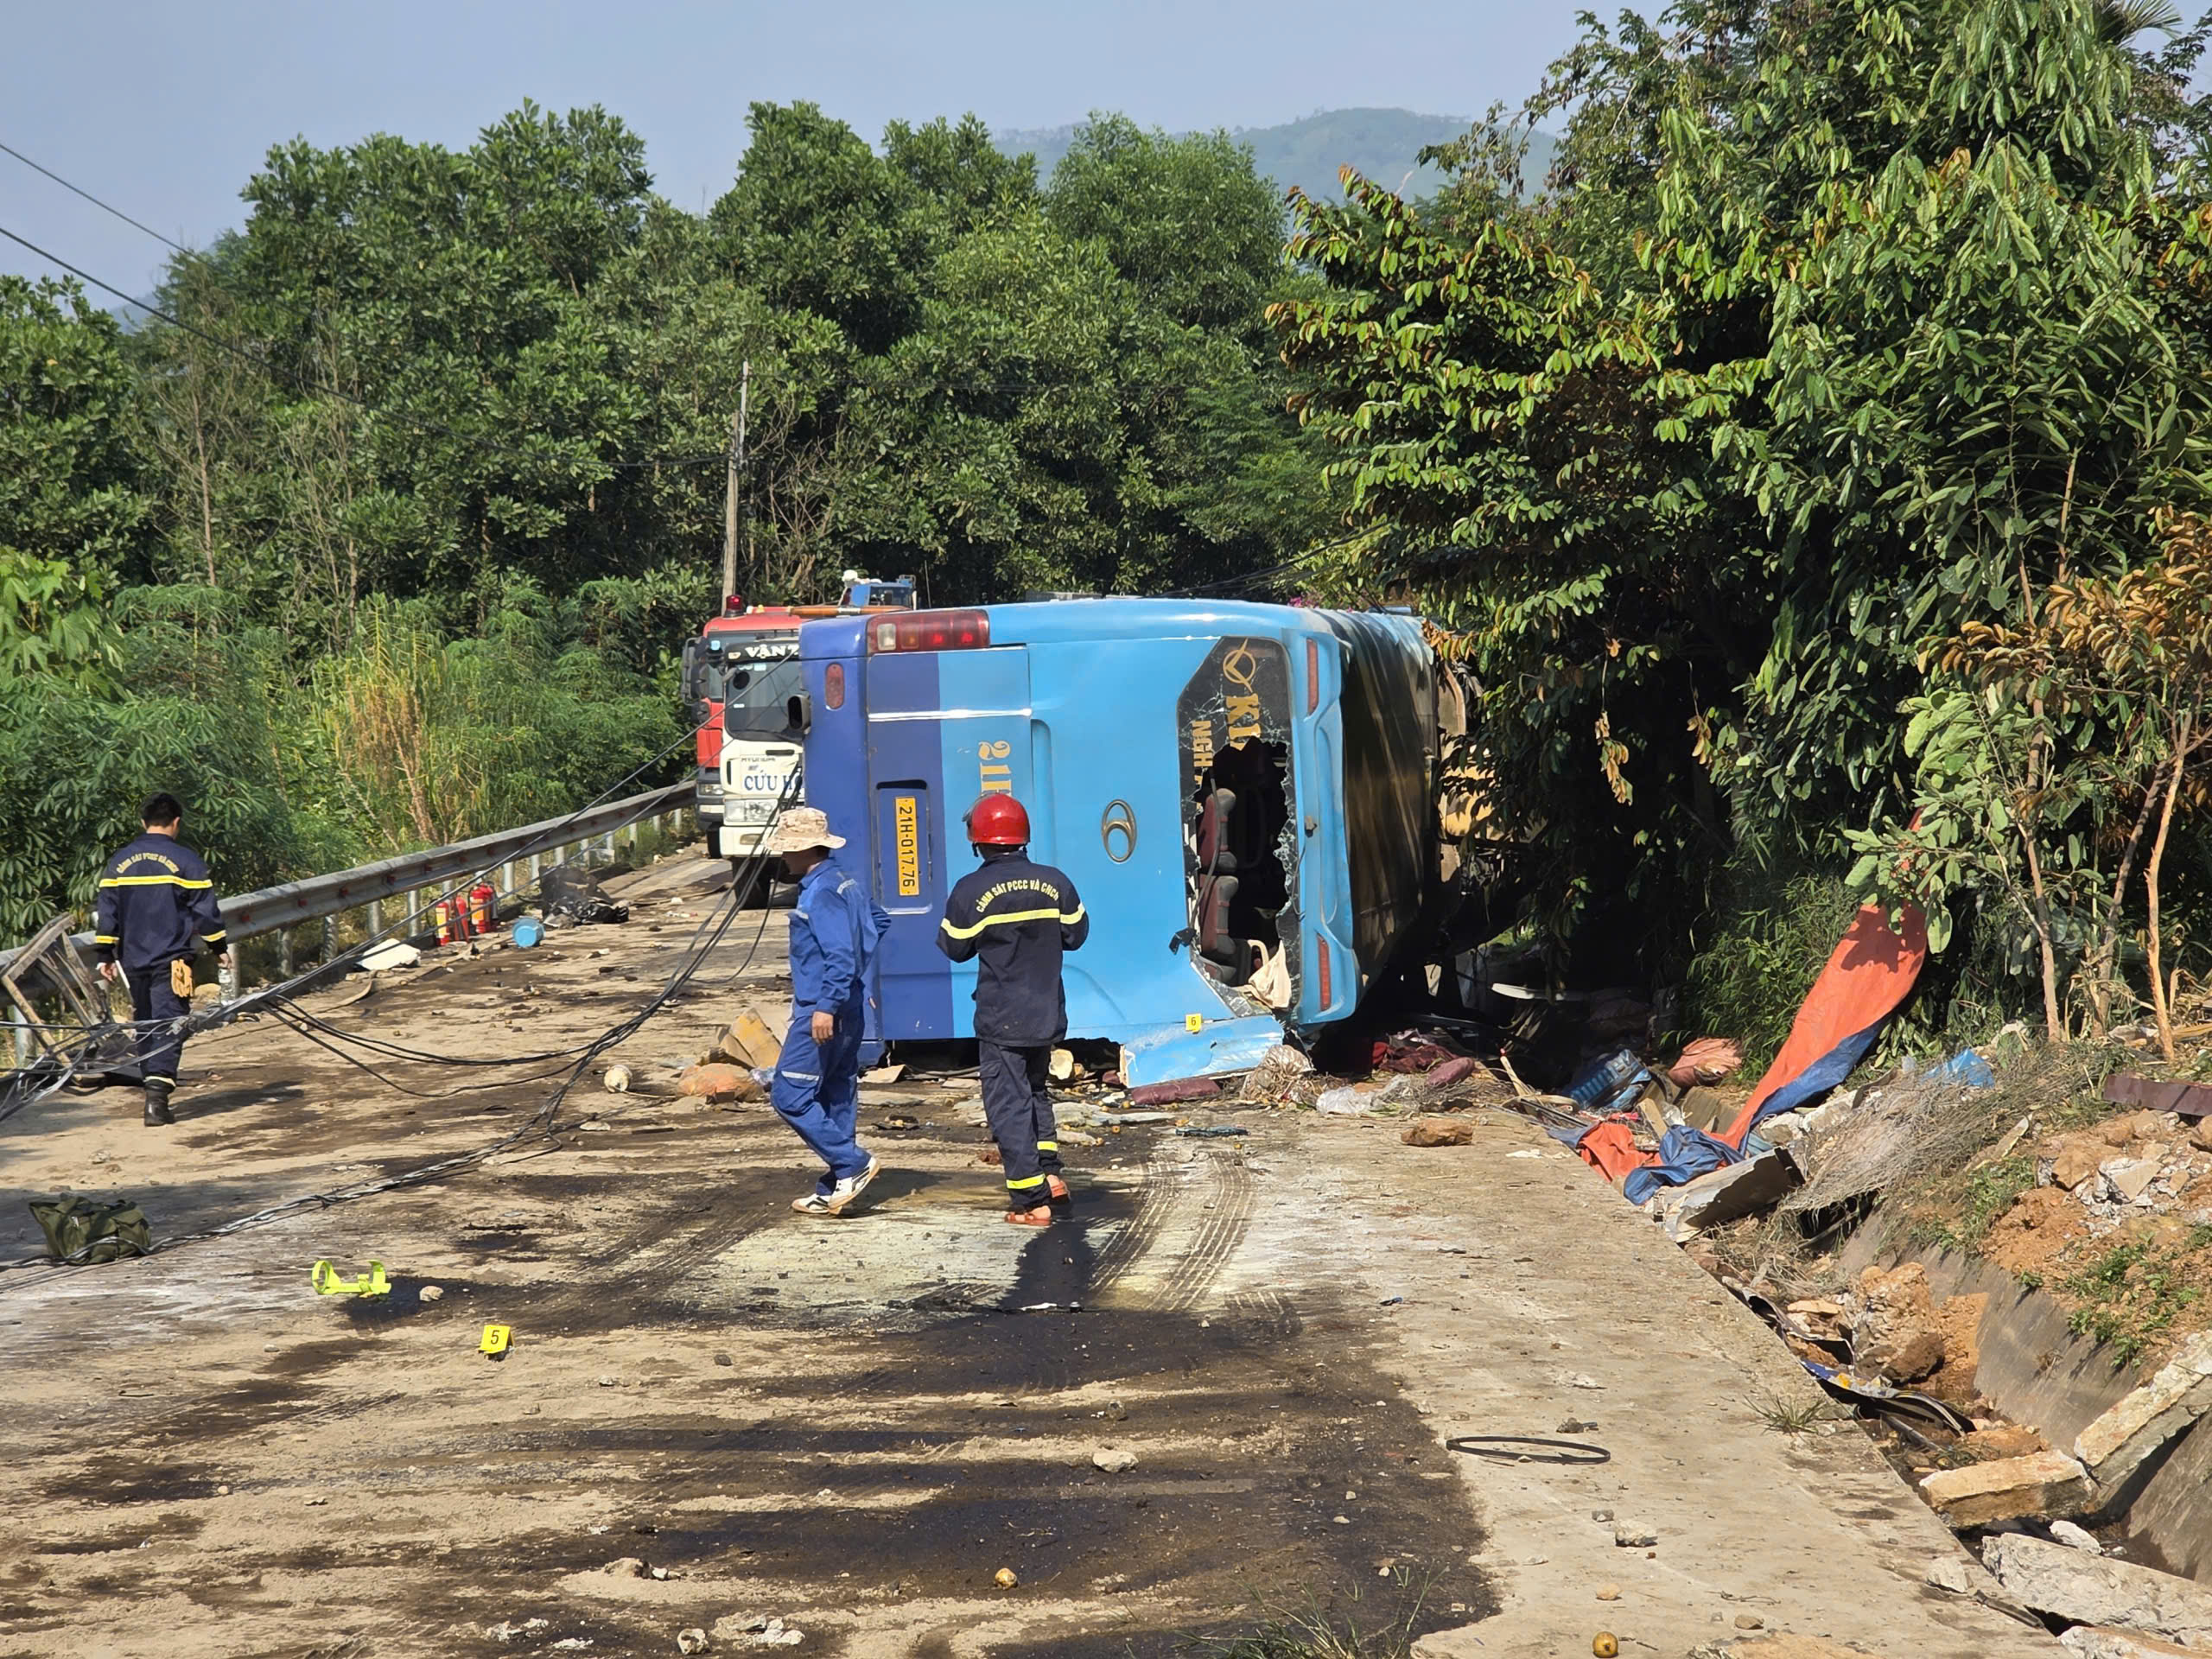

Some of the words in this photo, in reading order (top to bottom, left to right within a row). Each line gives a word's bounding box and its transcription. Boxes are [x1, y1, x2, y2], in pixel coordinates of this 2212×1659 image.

[745, 644, 786, 659] VẬN
[1225, 693, 1262, 751] KI
[899, 806, 916, 888] 21H-017.76
[991, 883, 1007, 896] SÁT
[1007, 879, 1028, 892] PCCC
[490, 1329, 499, 1345] 5
